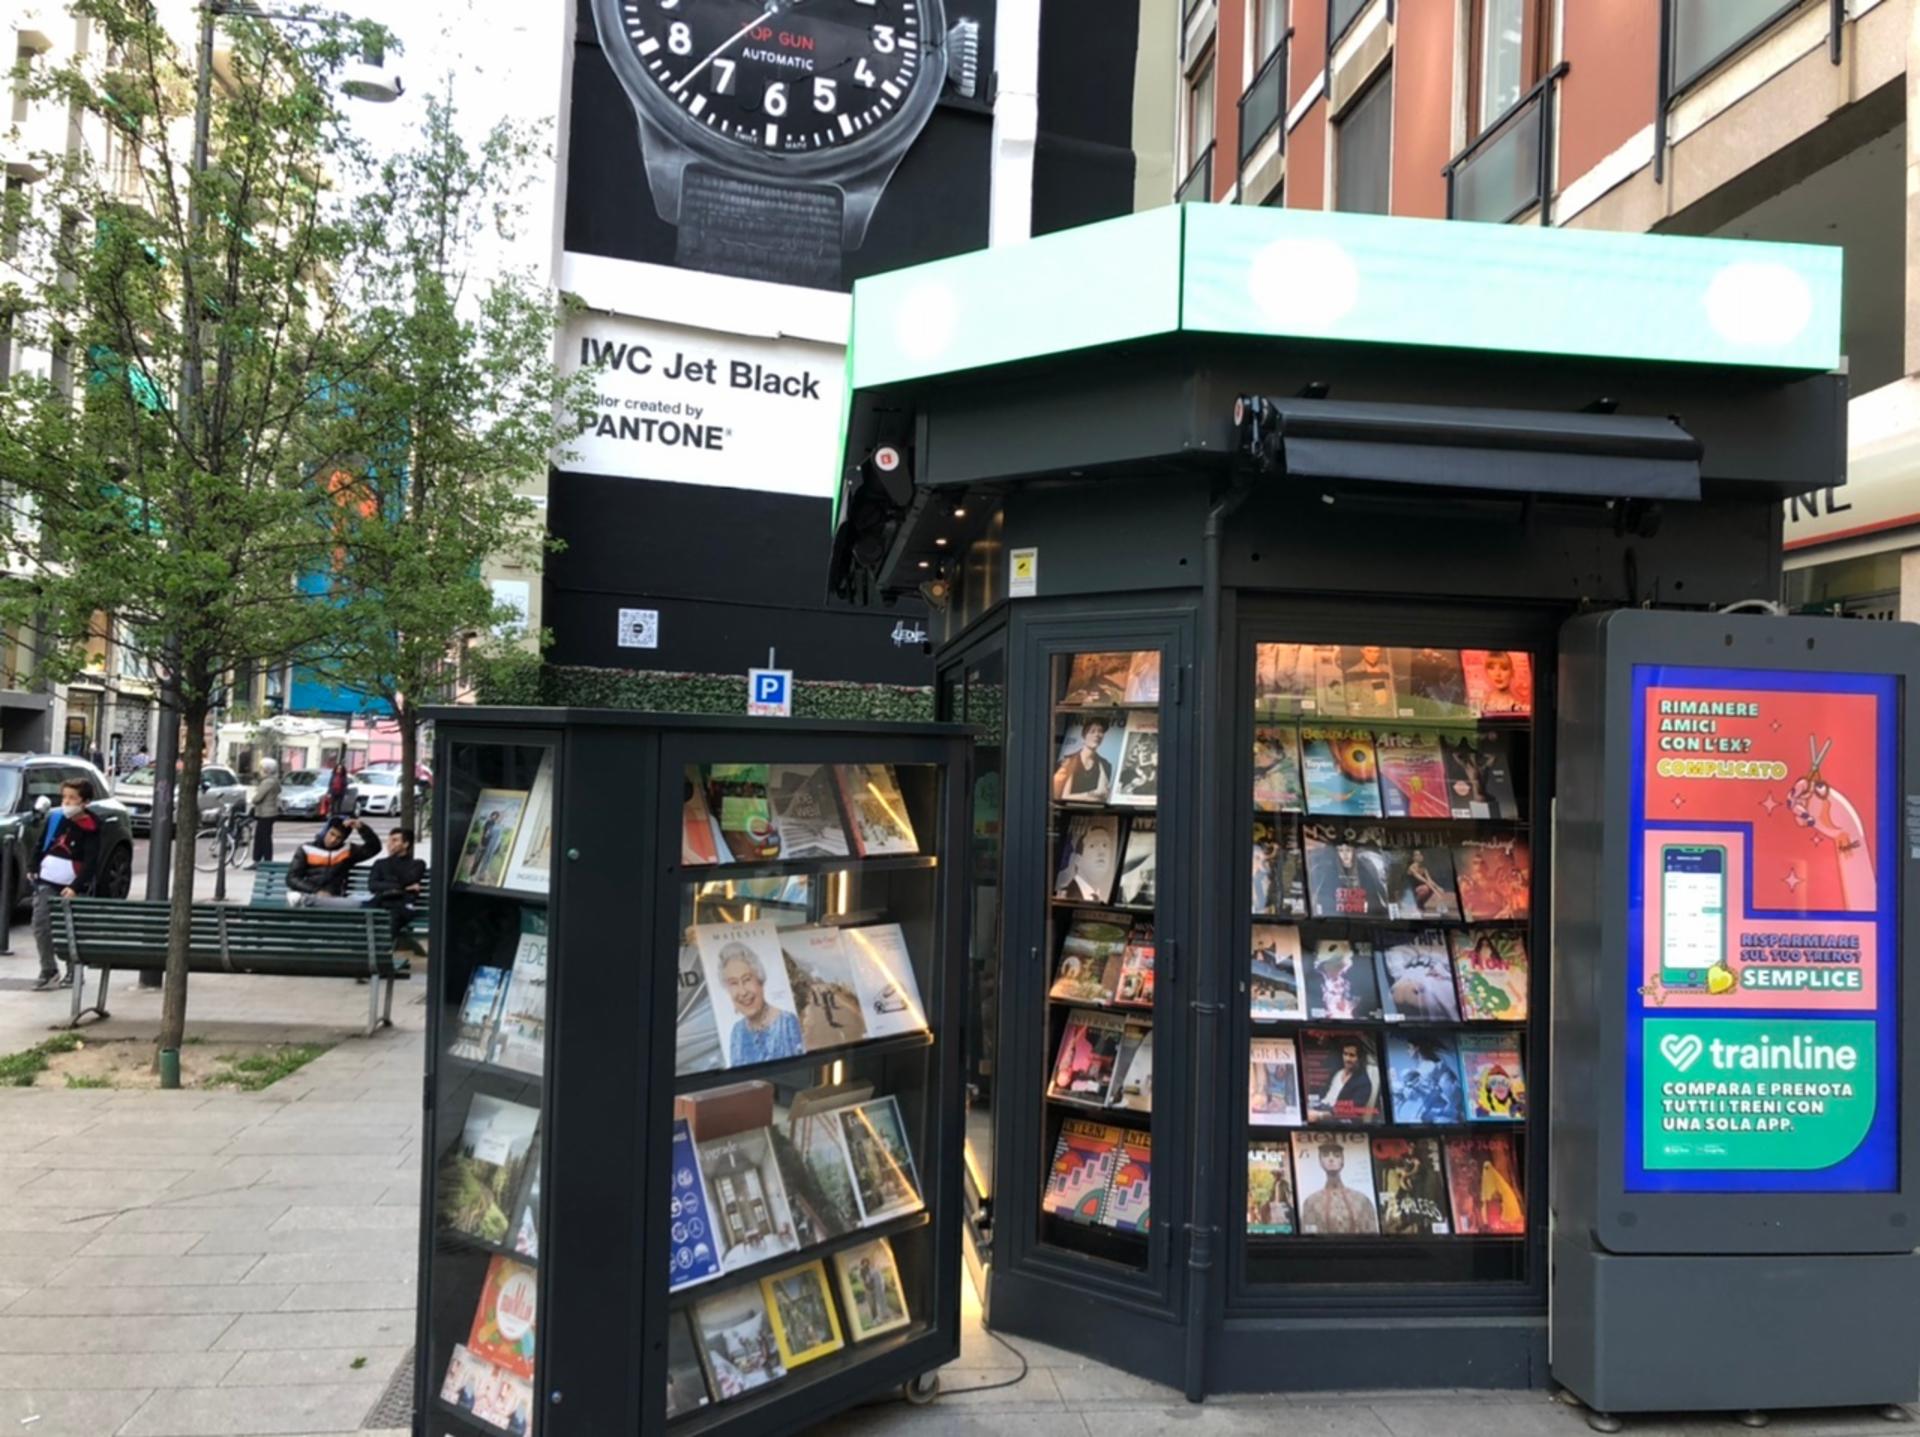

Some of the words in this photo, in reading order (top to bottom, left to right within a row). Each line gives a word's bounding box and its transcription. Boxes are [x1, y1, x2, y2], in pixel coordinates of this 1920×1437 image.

[669, 22, 692, 54] 8
[779, 31, 814, 50] GUN
[873, 24, 895, 54] 3
[742, 46, 814, 72] AUTOMATIC
[713, 59, 736, 95] 7
[854, 57, 876, 88] 4
[763, 81, 787, 116] 6
[813, 77, 838, 112] 5
[580, 336, 652, 374] IWC
[663, 352, 717, 385] Jet
[729, 359, 820, 400] Black
[624, 397, 682, 416] created
[685, 402, 704, 419] by
[577, 410, 724, 451] PANTONE
[761, 677, 779, 700] P
[1660, 700, 1759, 717] RIMANERE
[1660, 719, 1717, 734] AMICI
[1660, 736, 1700, 751] CON
[1704, 738, 1752, 753] L'EX?
[1657, 758, 1787, 780] COMPLICATO
[1741, 933, 1860, 949] RISPARMIARE
[1741, 949, 1768, 961] SUL
[1770, 949, 1802, 961] TUO
[1804, 950, 1861, 963] TRENO?
[1742, 969, 1860, 988] SEMPLICE
[1709, 1035, 1857, 1071] trainline
[1662, 1081, 1752, 1097] COMPARA
[1757, 1083, 1767, 1097] E
[1770, 1083, 1853, 1098] PRENOTA
[1662, 1099, 1716, 1114] TUTTI
[1719, 1100, 1725, 1114] I
[1729, 1100, 1782, 1114] TRENI
[1785, 1100, 1825, 1115] CON
[1662, 1117, 1702, 1132] UNA
[1705, 1117, 1752, 1132] SOLA
[1756, 1118, 1796, 1132] APP.
